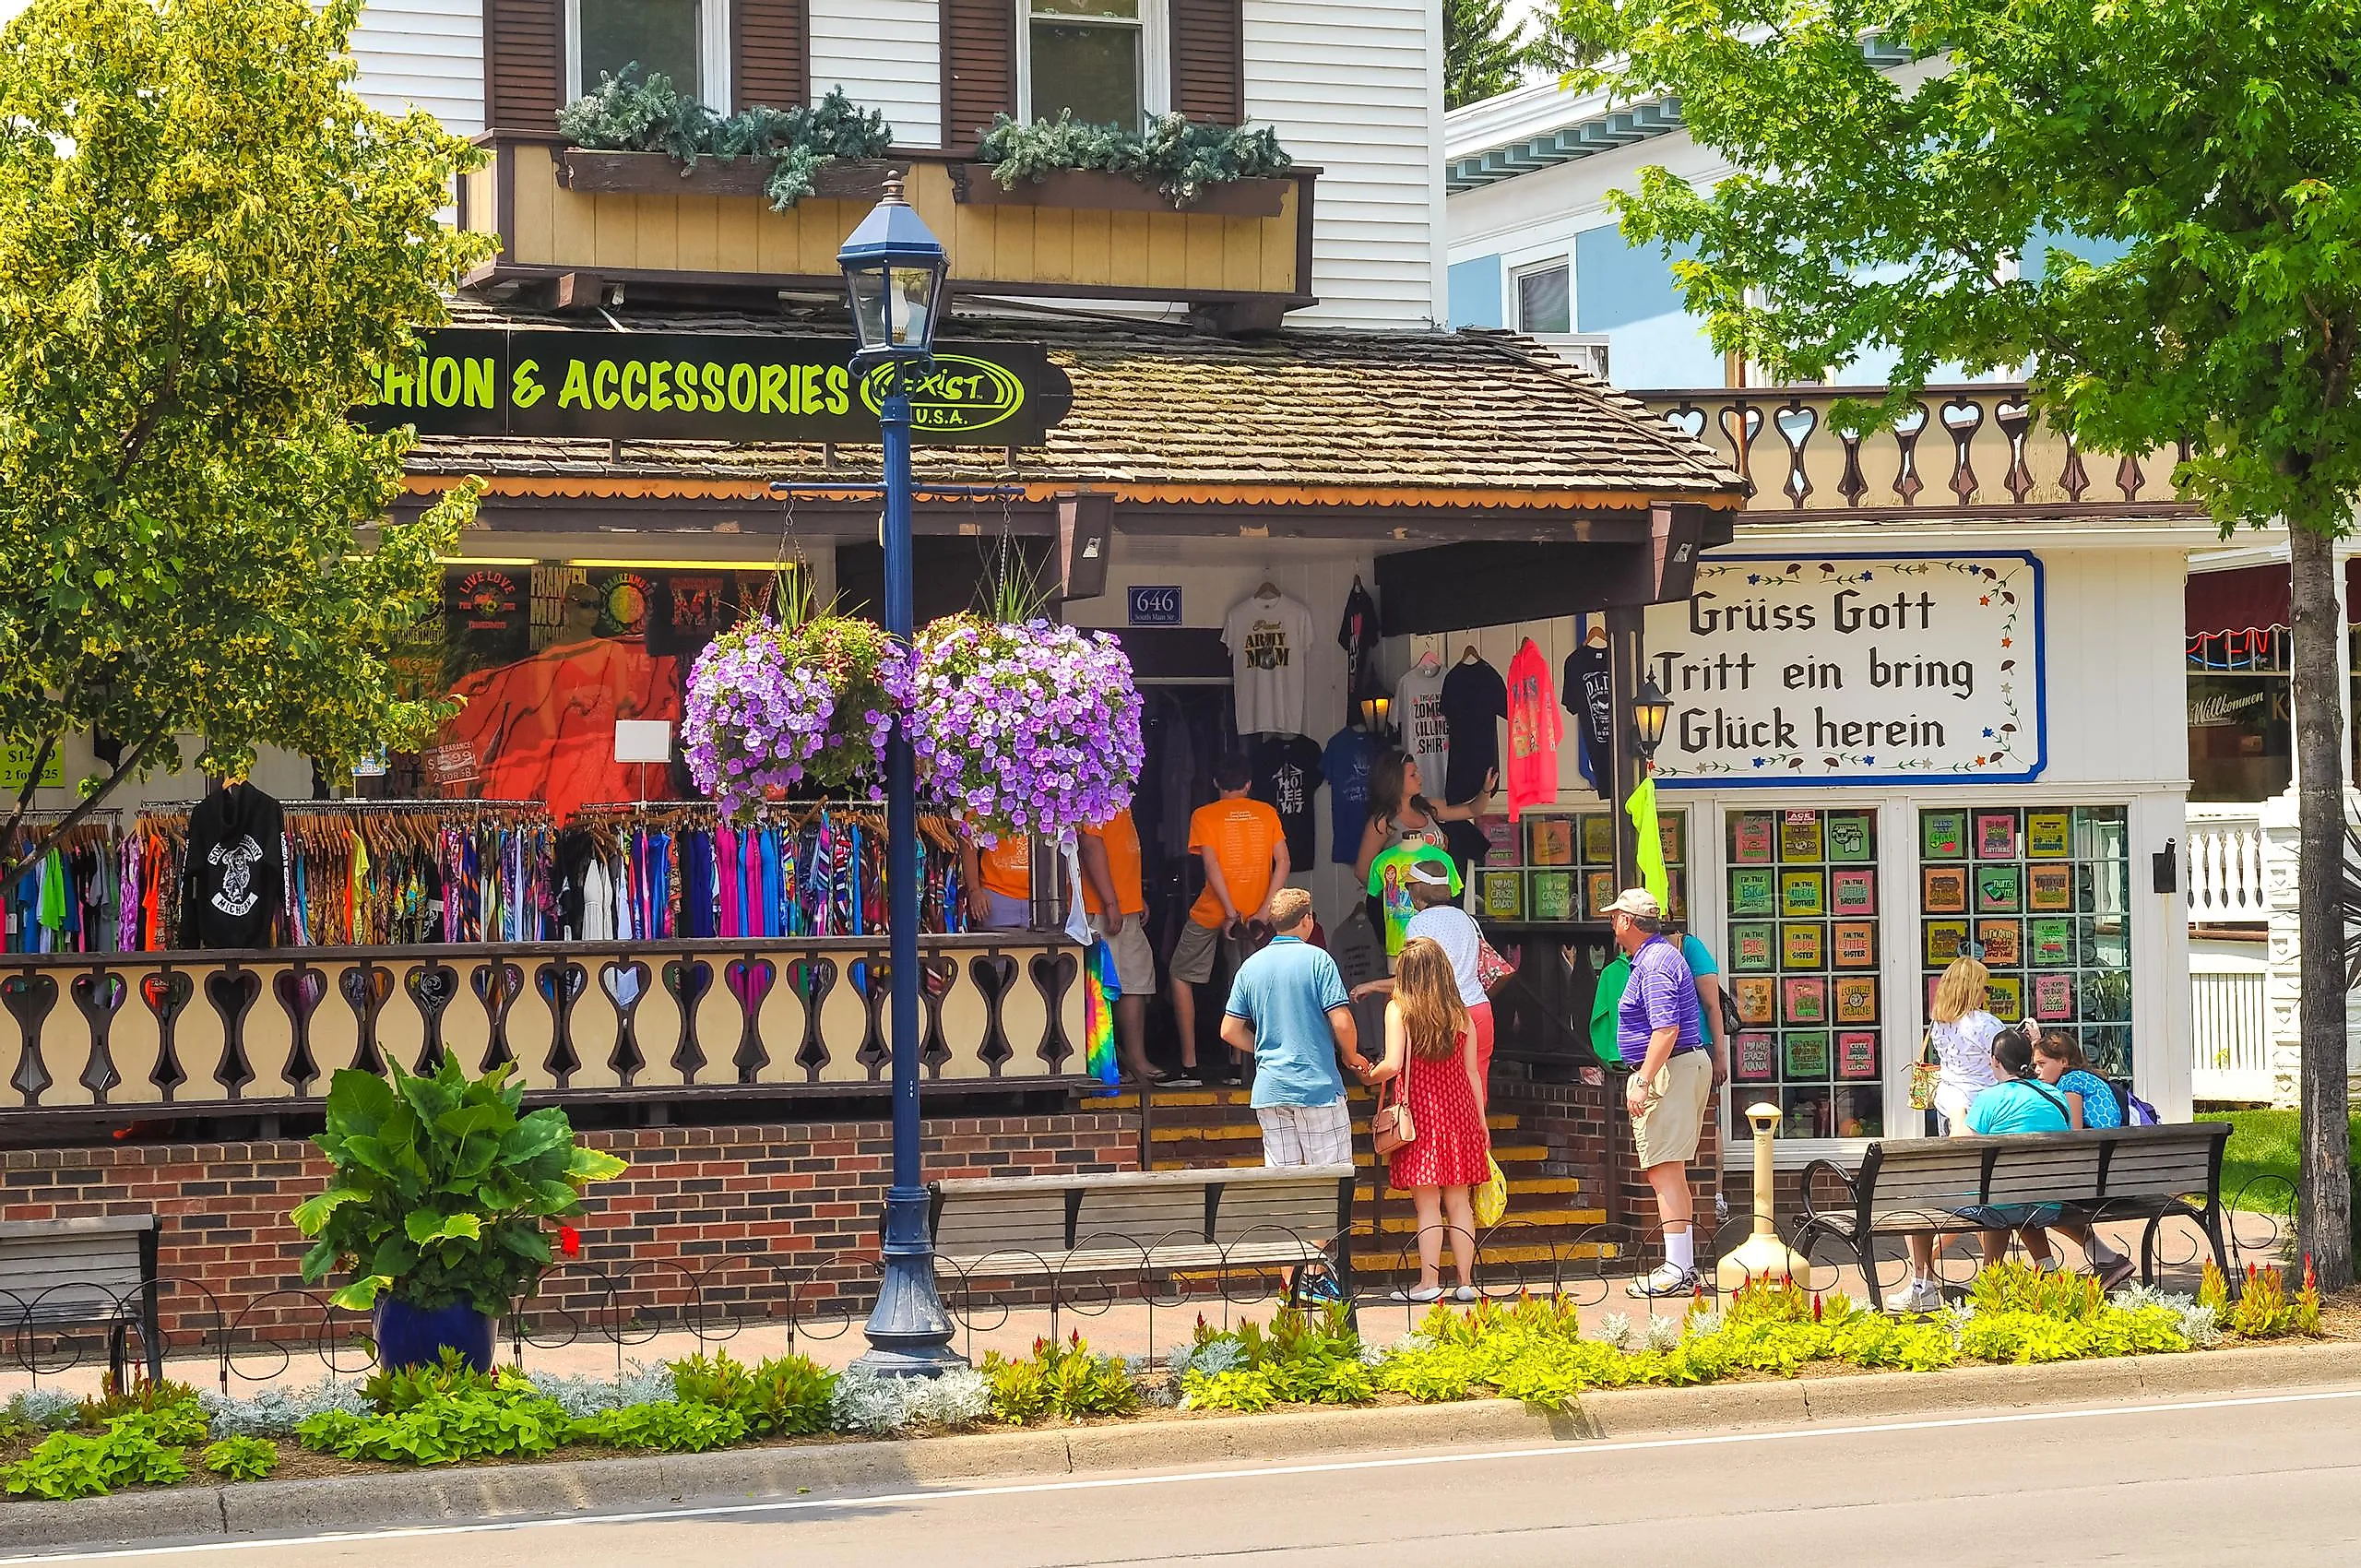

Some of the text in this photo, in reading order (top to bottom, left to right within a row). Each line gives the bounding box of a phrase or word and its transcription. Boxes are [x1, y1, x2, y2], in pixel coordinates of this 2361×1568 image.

[512, 359, 546, 408] &
[557, 359, 849, 415] ACCESSORIES
[916, 409, 968, 424] U.S.A.
[459, 570, 516, 594] LIVE LOVE
[1137, 590, 1173, 612] 646
[1690, 588, 1937, 636] Grüss Gott
[1653, 647, 1974, 700] Tritt ein bring
[2191, 692, 2264, 725] Willkommen
[1679, 706, 1946, 754] Glück herein
[6, 769, 12, 780] 2
[16, 769, 30, 780] fo
[1993, 879, 2014, 888] THAT'S
[1789, 899, 1816, 908] BROTHER
[1841, 897, 1867, 906] BROTHER
[1741, 940, 1764, 954] BIG
[1843, 949, 1866, 957] SISTER
[1741, 955, 1765, 963] SISTER
[1791, 951, 1814, 959] SISTER
[1841, 985, 1870, 996] FUTURE
[1742, 1051, 1768, 1061] CRAZY
